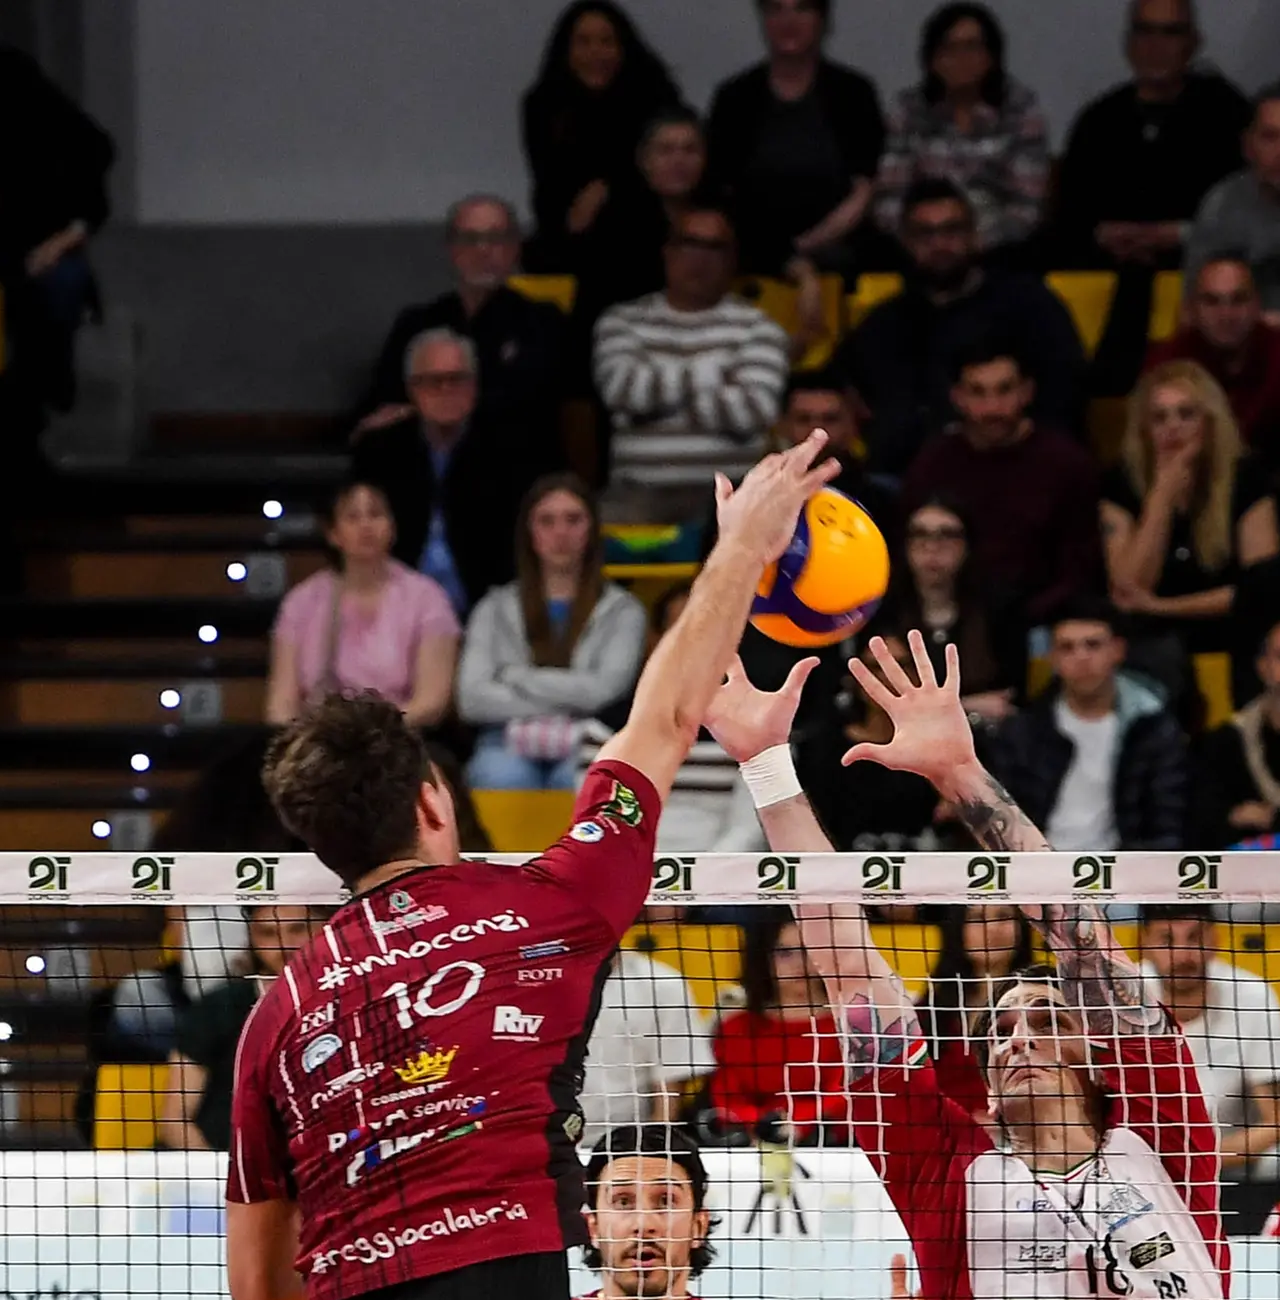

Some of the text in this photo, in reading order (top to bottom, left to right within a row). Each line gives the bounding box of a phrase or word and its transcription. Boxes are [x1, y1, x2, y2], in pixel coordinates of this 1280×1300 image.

[317, 909, 529, 991] #innocenzi
[381, 959, 487, 1030] 10
[310, 1200, 528, 1274] #reggiocalabria
